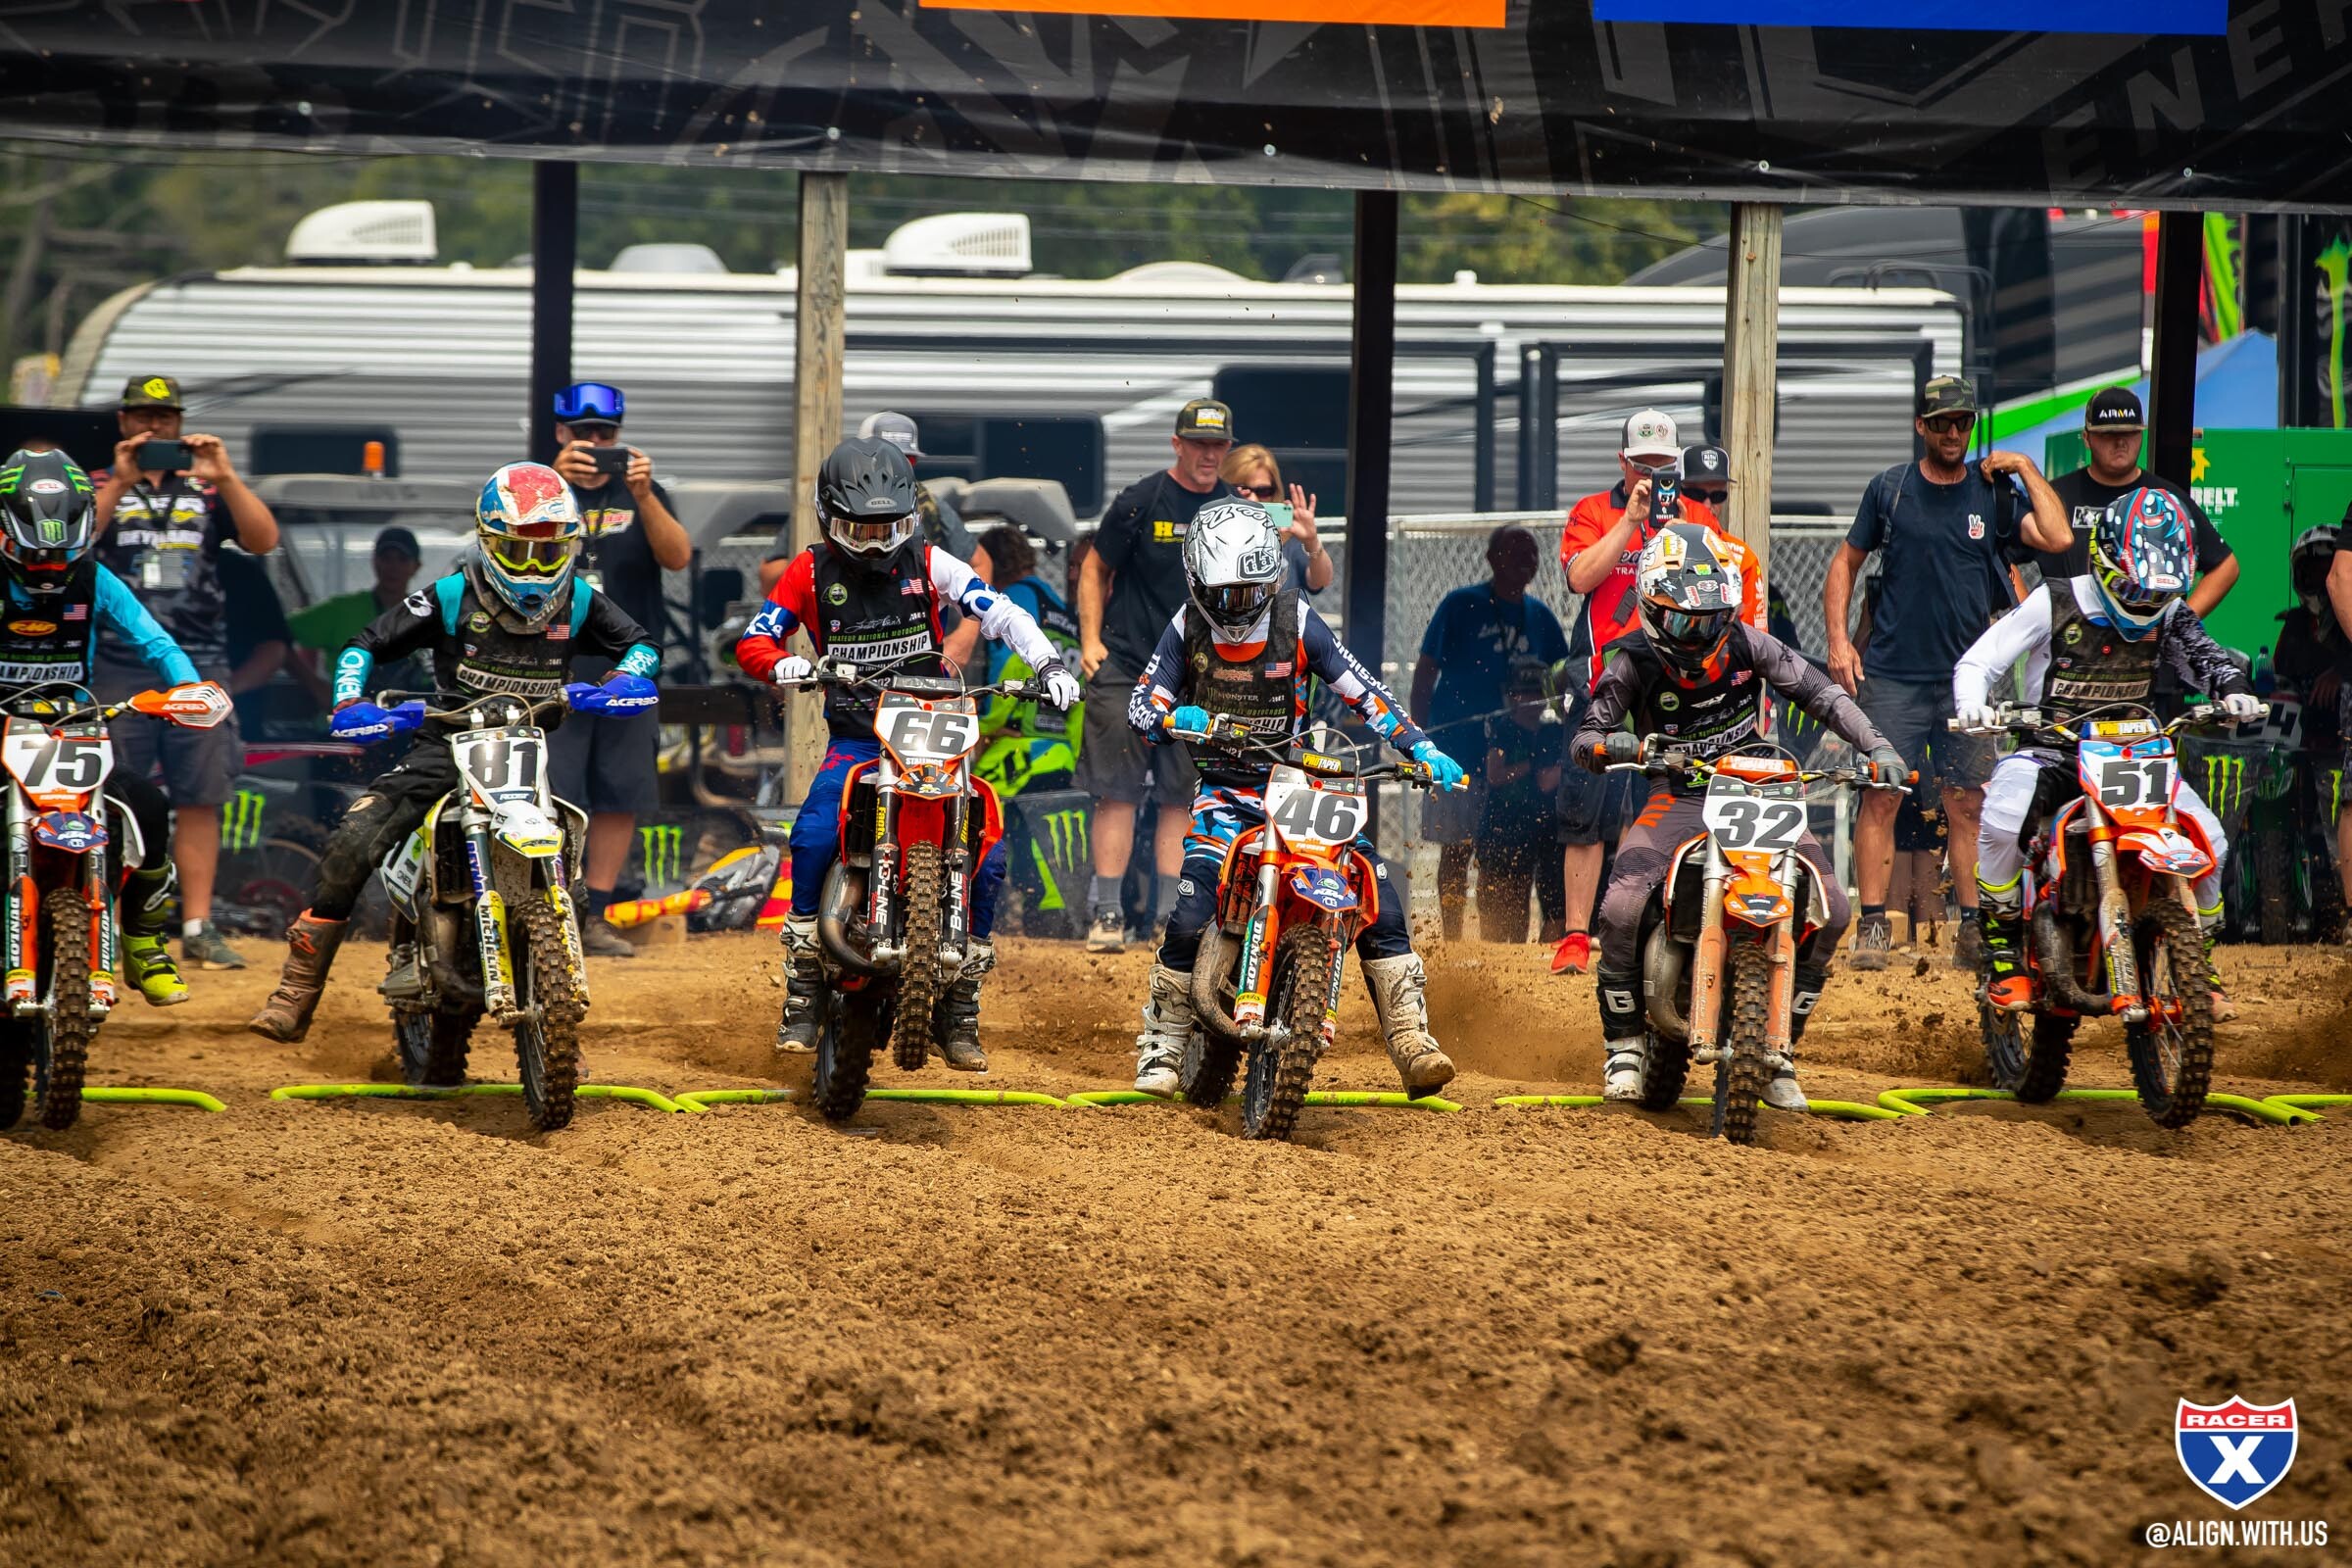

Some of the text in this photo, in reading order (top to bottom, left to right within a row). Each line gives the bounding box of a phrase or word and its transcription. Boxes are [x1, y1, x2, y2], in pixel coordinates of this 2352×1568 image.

[2099, 408, 2136, 418] ARMA
[831, 634, 928, 661] CHAMPIONSHIP
[458, 669, 560, 697] CHAMPIONSHIP
[1217, 693, 1259, 703] MONSTER
[888, 710, 969, 756] 66
[21, 740, 102, 787] 75
[468, 741, 538, 789] 81
[2101, 760, 2170, 806] 51
[1273, 788, 1360, 841] 46
[1713, 800, 1804, 849] 32
[950, 870, 963, 931] B-LINE
[10, 896, 21, 967] DUNLOP
[479, 905, 499, 984] MICHELIN
[1246, 920, 1263, 991] DUNLOP
[1329, 950, 1343, 1009] DUNLOP
